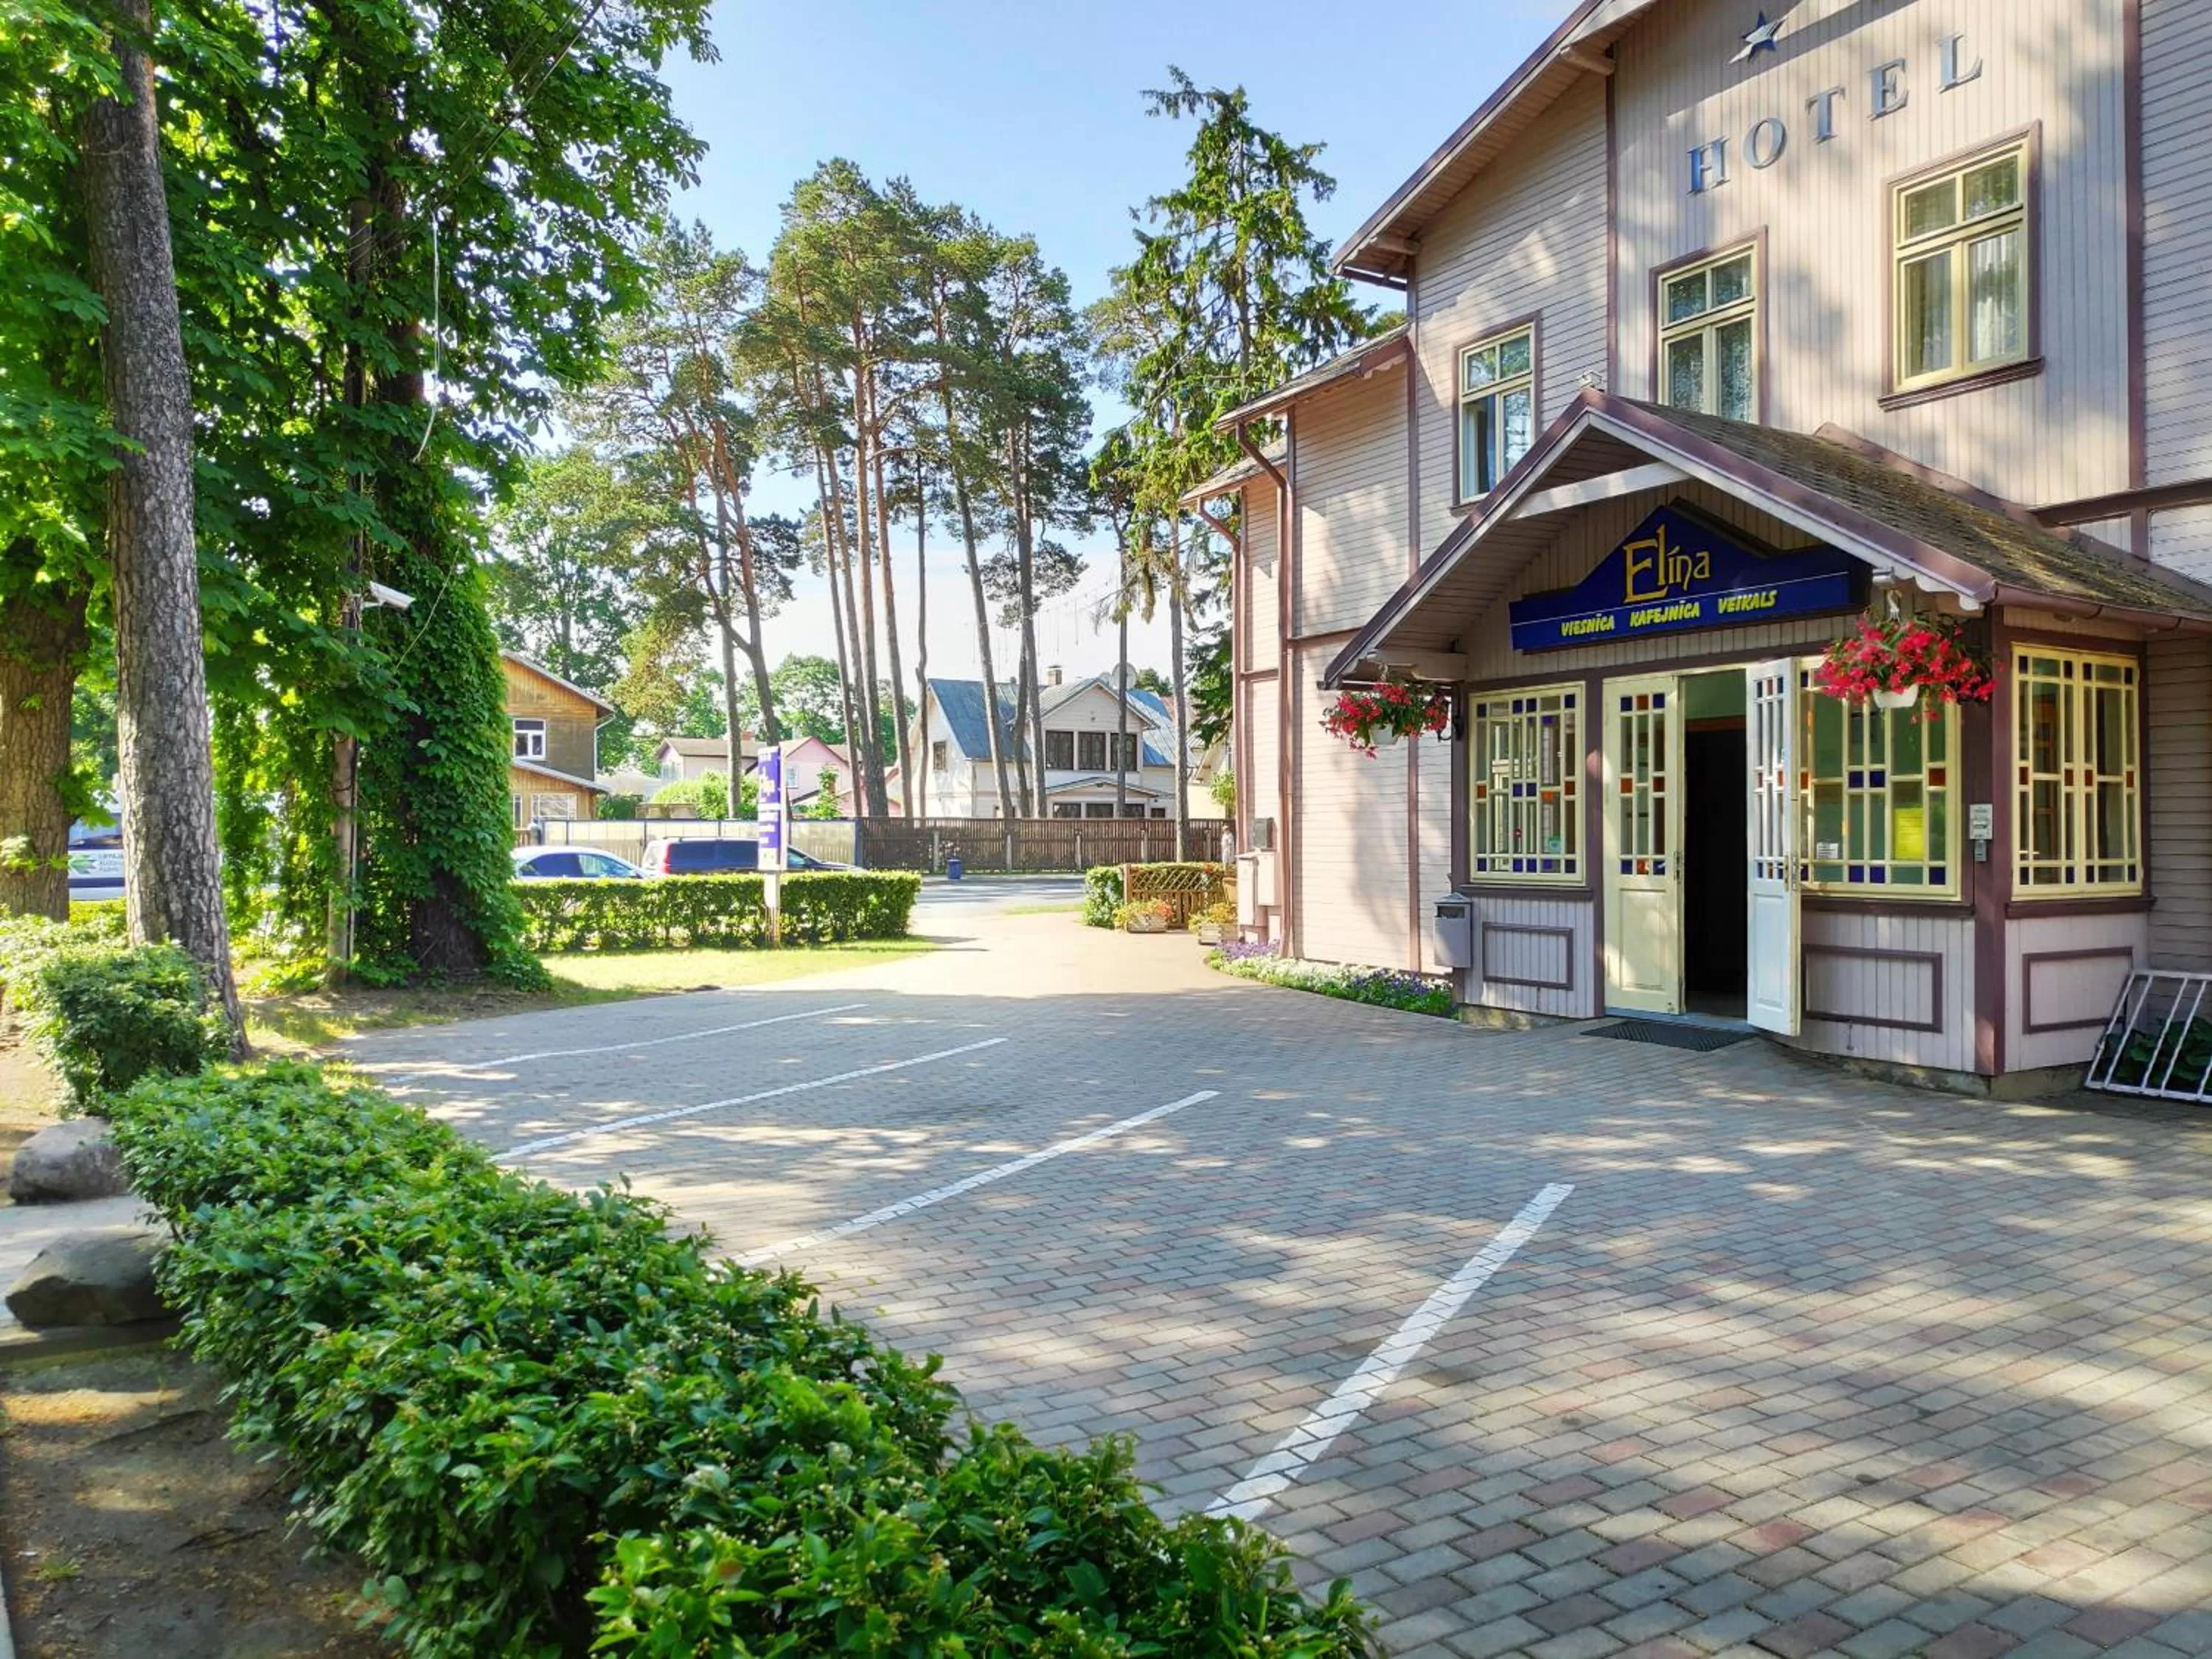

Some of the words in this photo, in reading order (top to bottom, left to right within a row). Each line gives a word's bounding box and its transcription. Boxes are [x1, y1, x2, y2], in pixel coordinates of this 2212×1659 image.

[1686, 32, 1983, 196] HOTEL
[1561, 613, 1615, 636] VIESNĪCA
[1630, 599, 1700, 627] KAFEJNĪCA
[1717, 589, 1778, 614] VEIKALS
